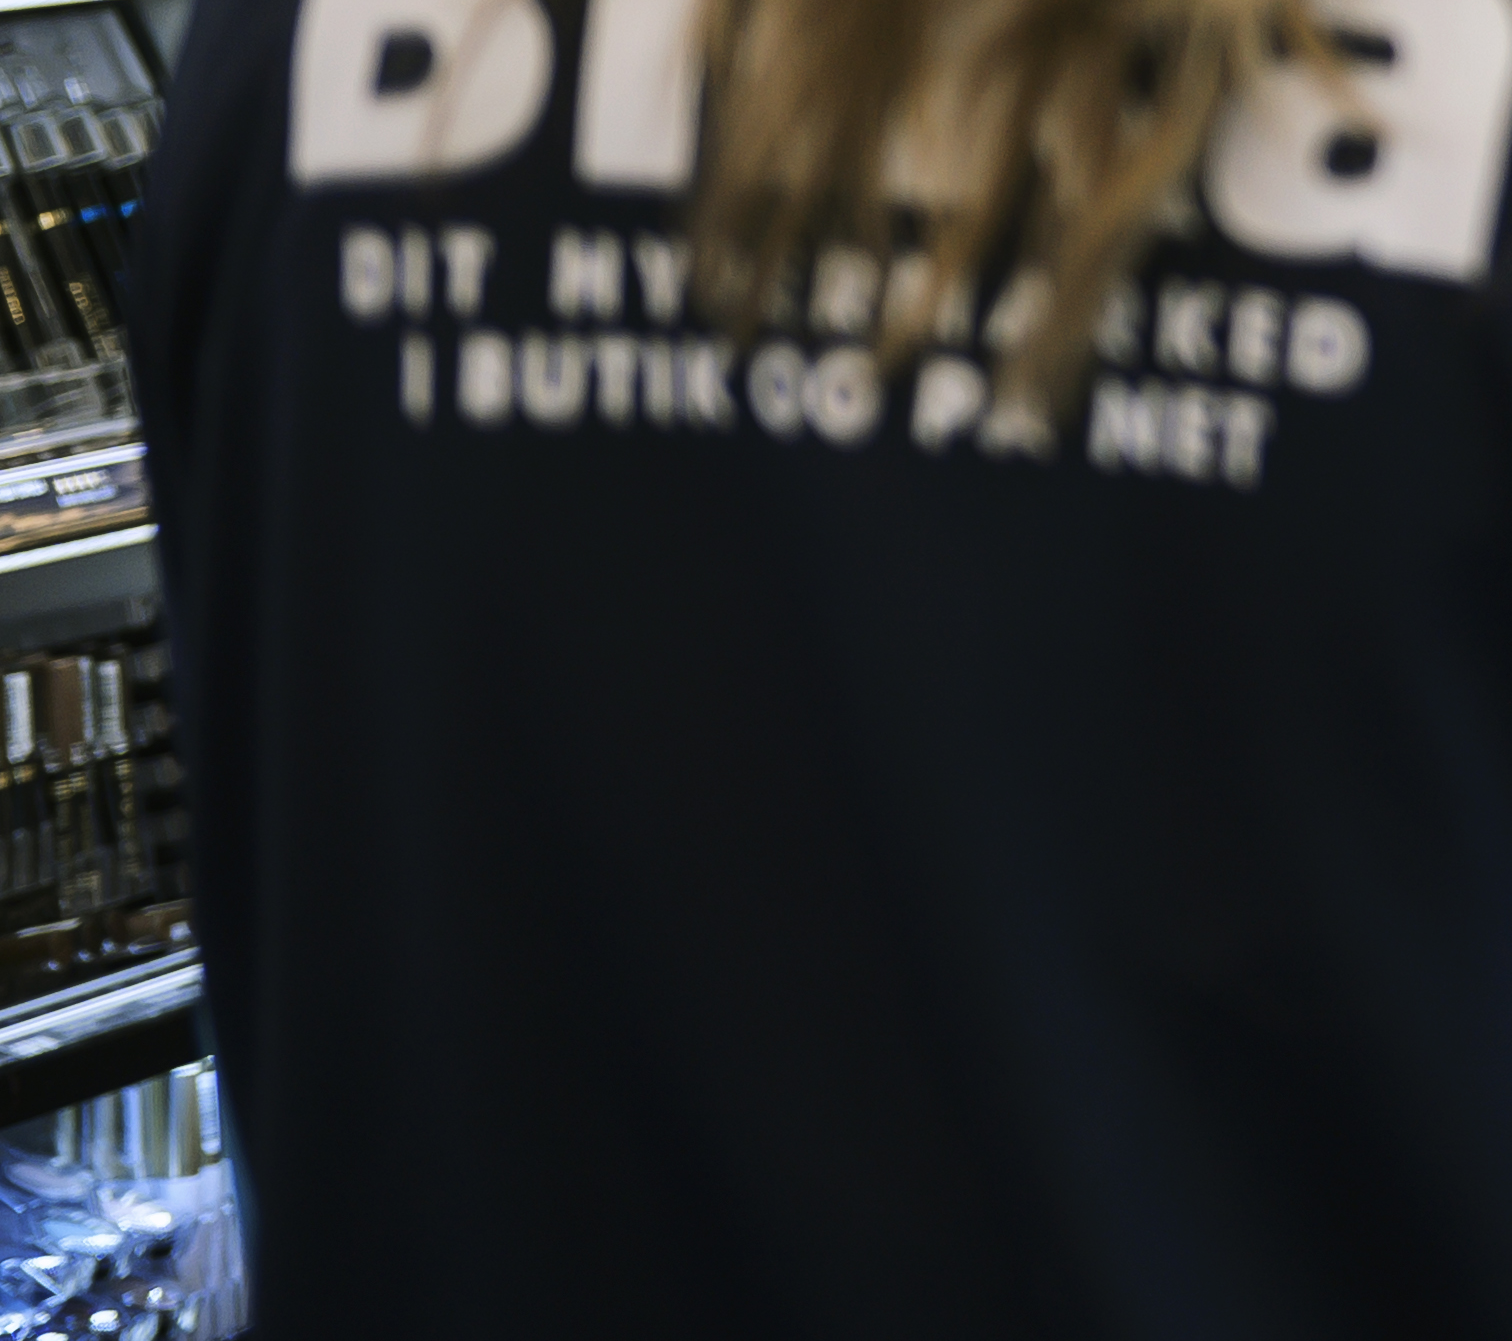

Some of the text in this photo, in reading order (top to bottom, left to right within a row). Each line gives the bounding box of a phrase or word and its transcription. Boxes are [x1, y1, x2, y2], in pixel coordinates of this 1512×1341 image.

[340, 224, 495, 322] DIT
[402, 331, 436, 429] I
[455, 327, 736, 429] BUTIK
[746, 338, 884, 450] OG
[1088, 375, 1276, 493] NET
